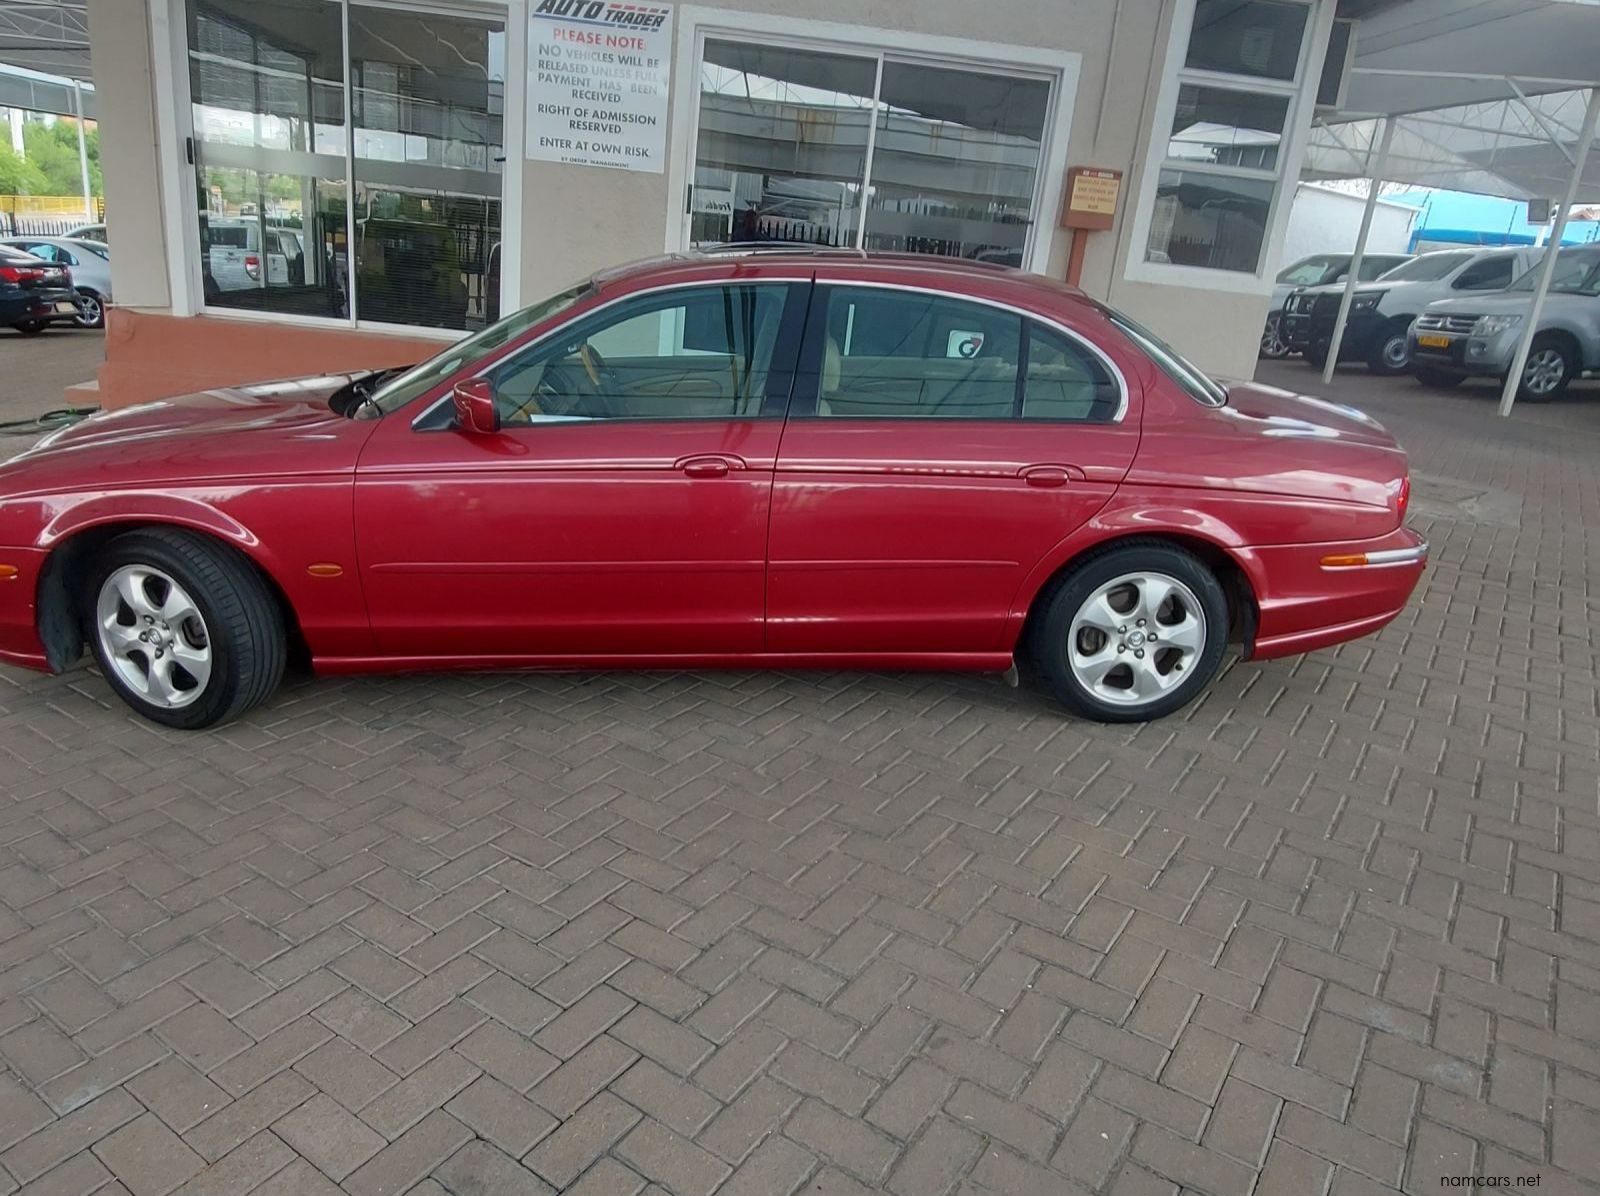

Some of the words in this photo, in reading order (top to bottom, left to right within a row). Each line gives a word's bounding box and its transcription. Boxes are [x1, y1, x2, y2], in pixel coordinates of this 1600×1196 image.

[535, 0, 605, 19] AUTO
[604, 9, 666, 27] TRADER
[553, 28, 601, 45] PLEASE
[538, 43, 561, 57] NO
[566, 49, 614, 64] VEHICLES
[618, 54, 643, 67] WILL
[647, 58, 660, 68] BE
[538, 59, 589, 75] RELEASED
[592, 66, 632, 80] UNLESS
[635, 71, 657, 83] FULL
[538, 73, 591, 87] PAYMENT
[600, 80, 622, 91] HAS
[631, 83, 658, 95] BEEN
[572, 89, 621, 103] RECEIVED
[538, 103, 571, 117] RIGHT
[574, 107, 589, 118] OF
[592, 110, 656, 126] ADMISSION
[540, 137, 572, 150] ENTER
[575, 141, 588, 151] AT
[592, 143, 621, 154] OWN
